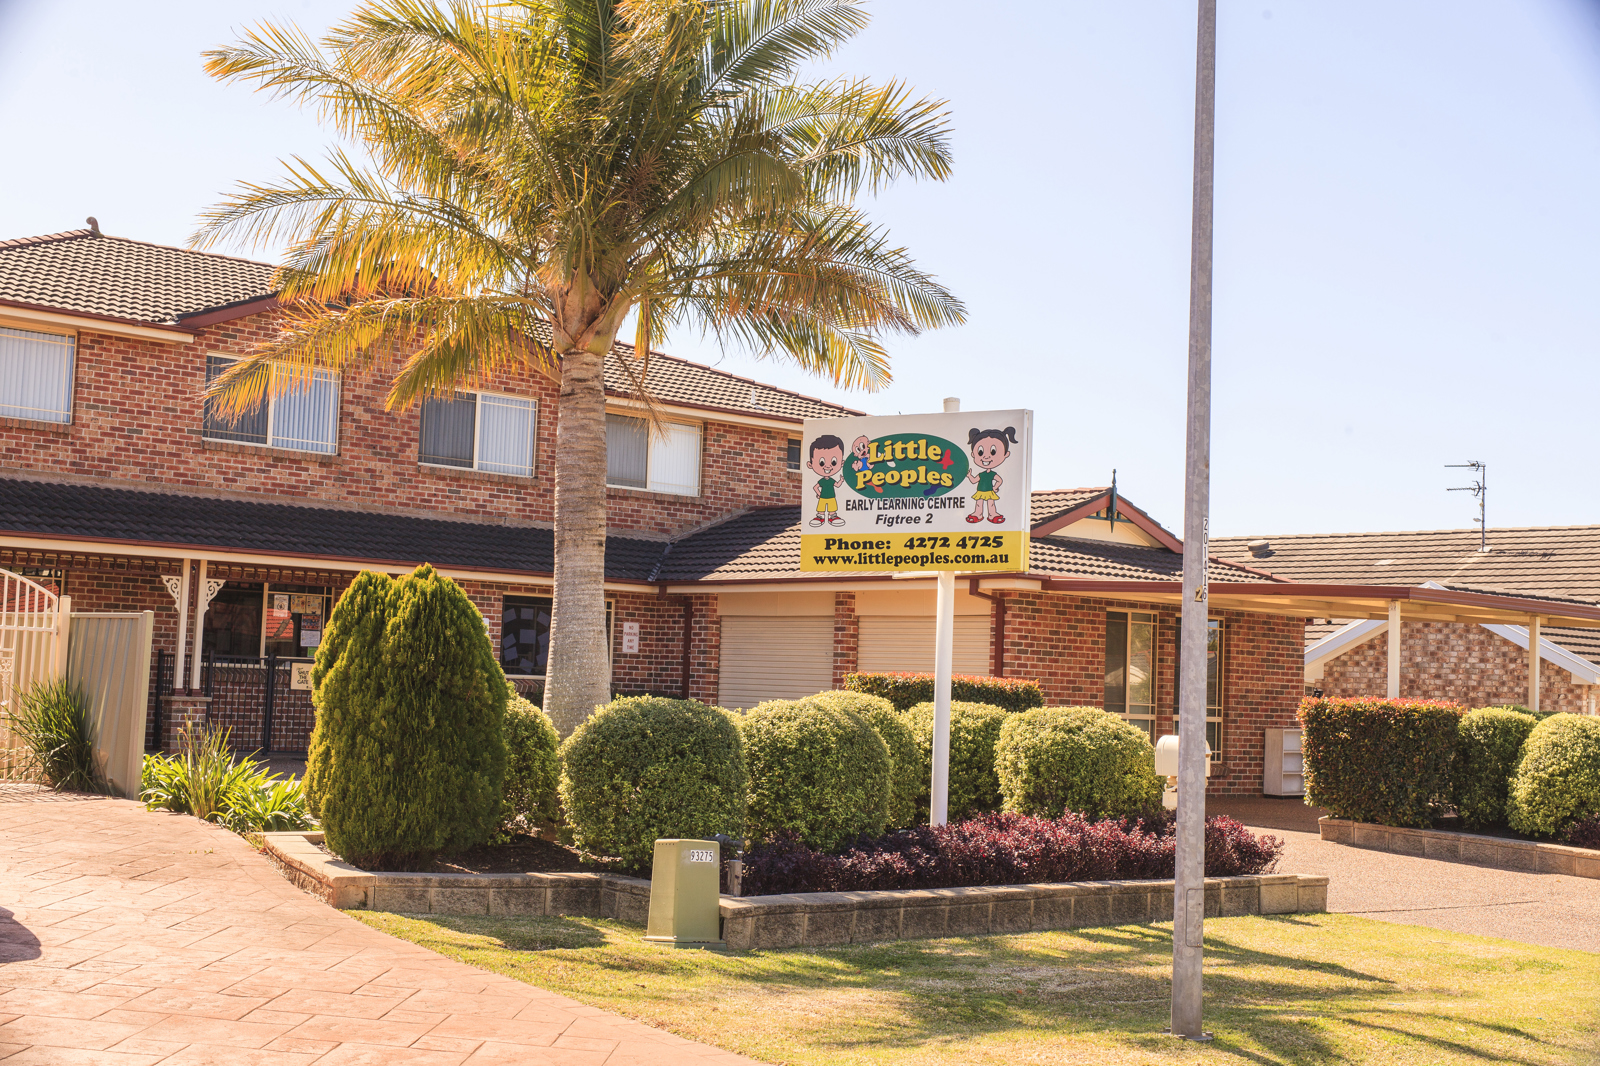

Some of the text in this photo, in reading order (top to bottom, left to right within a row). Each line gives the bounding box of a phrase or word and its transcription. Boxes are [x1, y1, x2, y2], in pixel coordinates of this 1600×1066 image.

[868, 439, 943, 464] Little
[855, 465, 954, 491] Peoples
[845, 496, 966, 511] EARLY LEARNING CENTRE
[875, 513, 934, 527] Figtree 2
[824, 535, 1004, 550] Phone: 4272 4725
[813, 552, 1009, 567] www.littlepeoples.com.au
[690, 850, 713, 861] 93275
